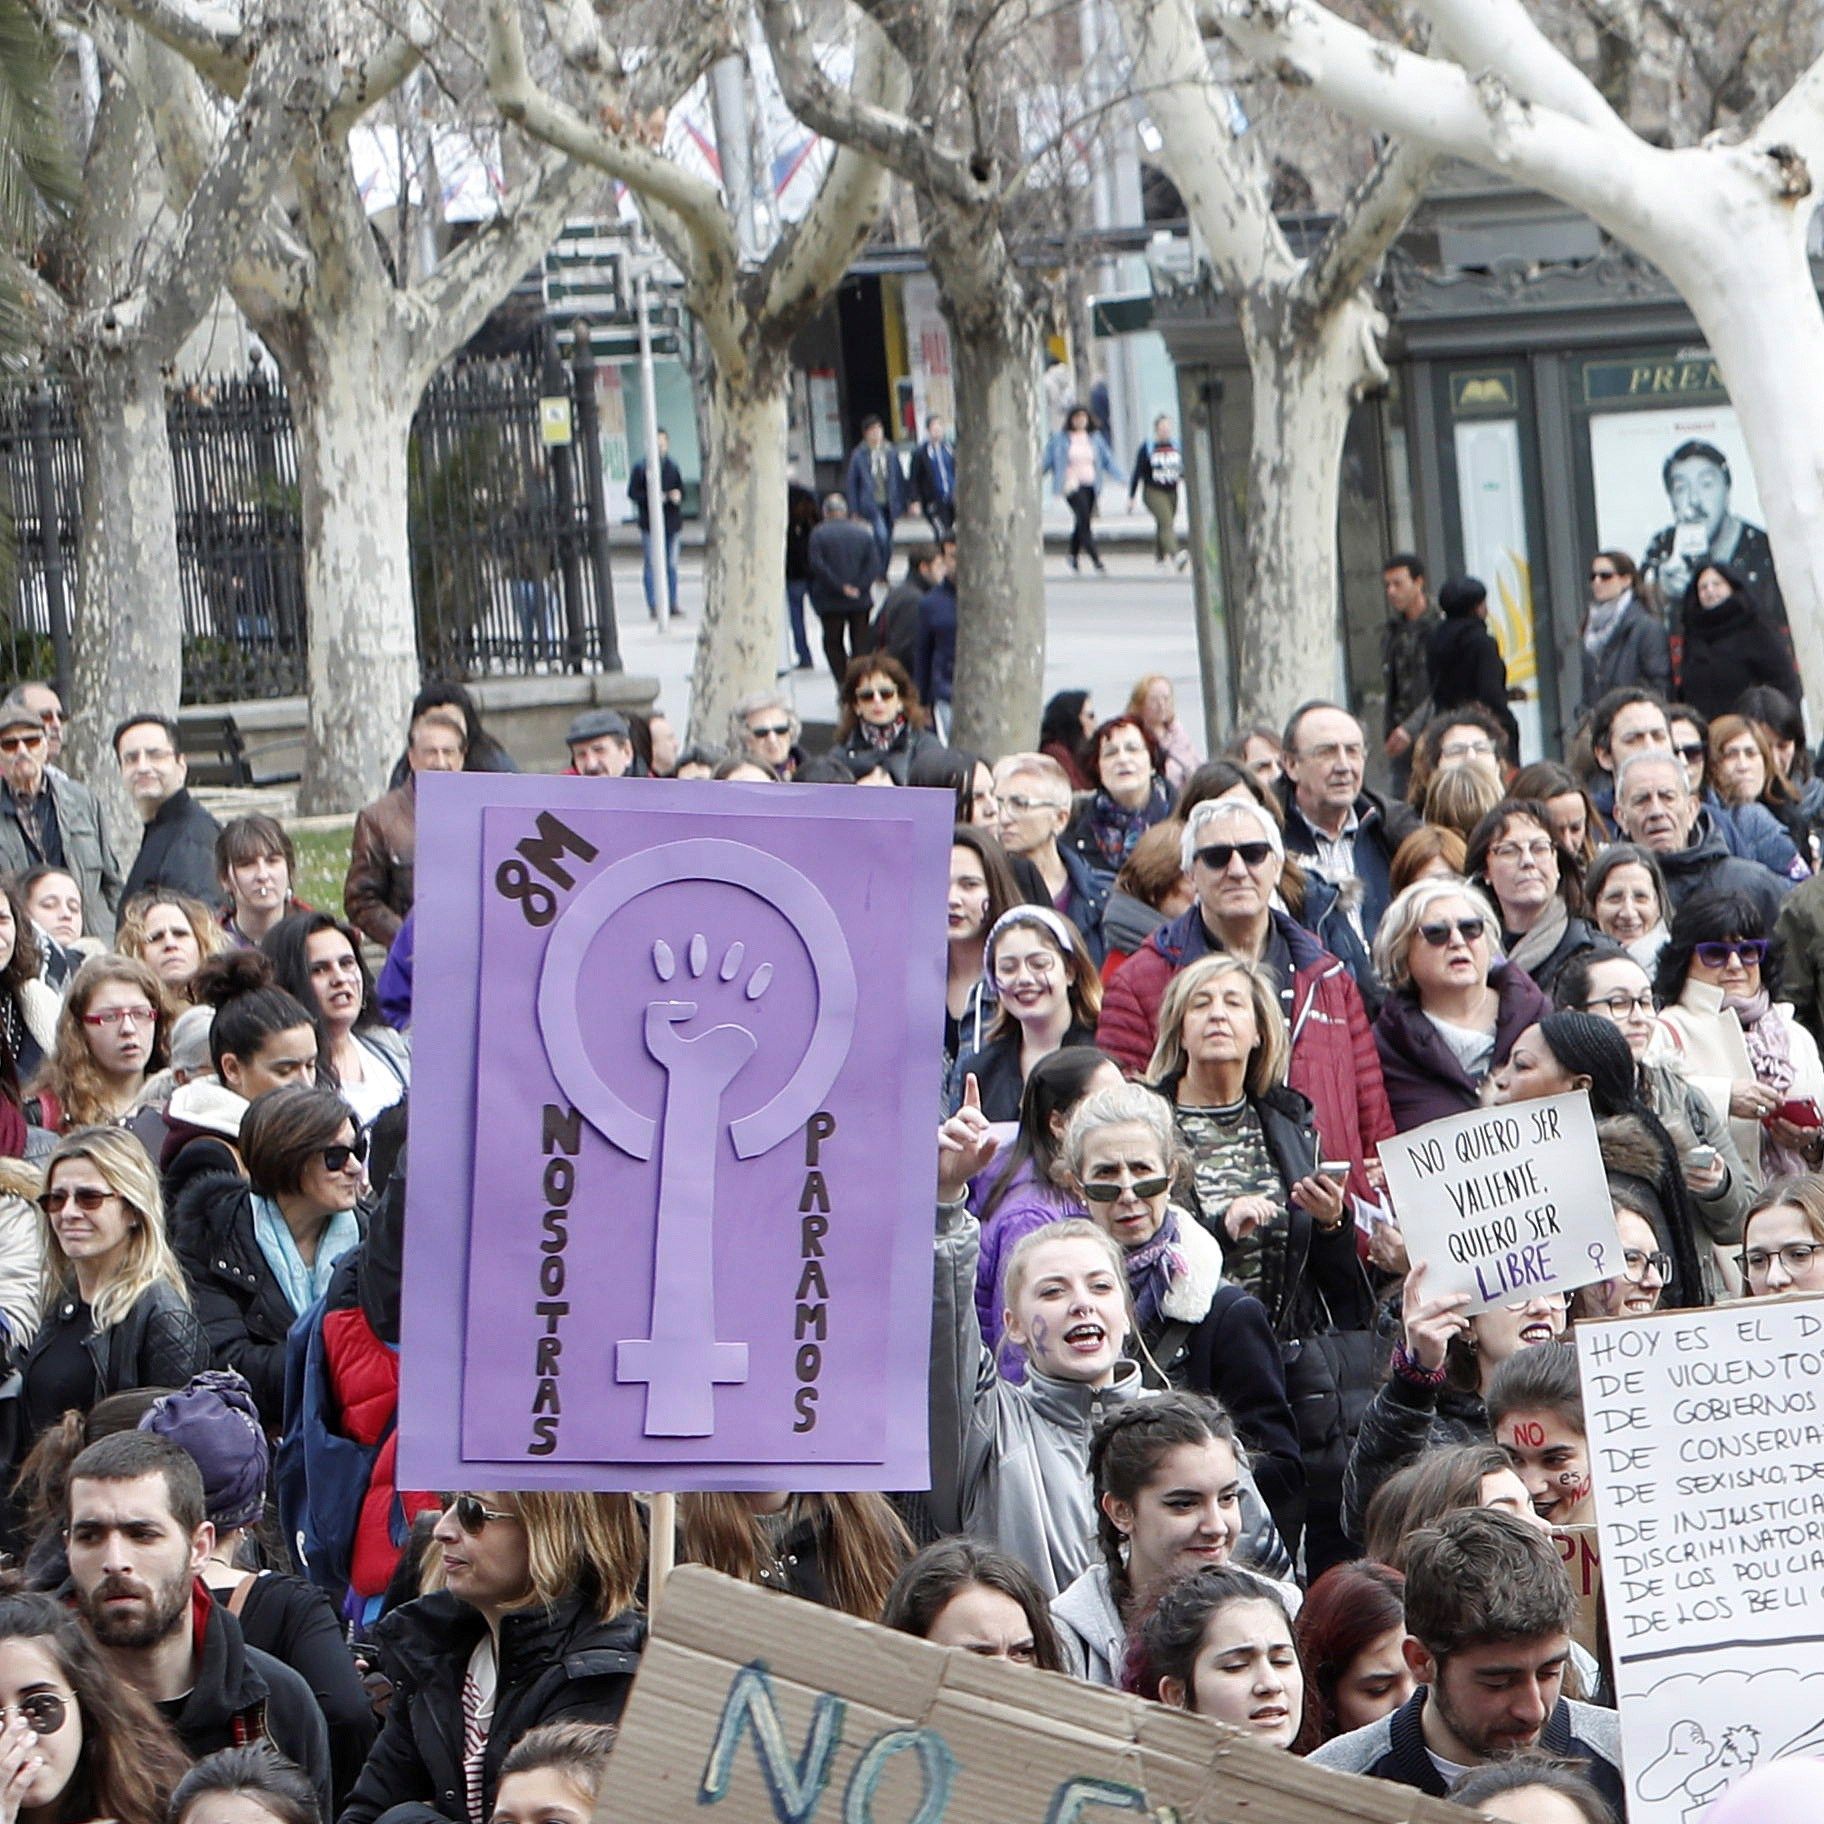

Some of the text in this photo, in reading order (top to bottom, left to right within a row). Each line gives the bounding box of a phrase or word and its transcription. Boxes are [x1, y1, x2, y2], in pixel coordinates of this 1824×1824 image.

[1628, 359, 1726, 395] PREN
[494, 810, 600, 927] 8M
[1407, 1106, 1562, 1179] NO QUIERO SER
[1448, 1203, 1561, 1264] QUIERO SER
[527, 1104, 582, 1456] NOSOTRAS
[792, 1112, 836, 1434] PARAMOS
[1475, 1242, 1558, 1303] LIBRE
[1591, 1331, 1660, 1366] HOY
[1675, 1326, 1709, 1351] ES
[1737, 1319, 1772, 1342] EL
[1592, 1371, 1644, 1398] DE
[1594, 1407, 1652, 1434] DE
[1674, 1391, 1816, 1425] GOBIERNOS
[1514, 1422, 1544, 1447] NO
[1560, 1471, 1580, 1485] es
[1600, 1446, 1657, 1473] DE
[1571, 1474, 1591, 1506] NO
[1607, 1483, 1656, 1507] DE
[1607, 1519, 1658, 1546] DE
[1620, 1580, 1664, 1603] DE
[1675, 1568, 1715, 1591] LOS
[1624, 1610, 1671, 1639] DE
[1677, 1596, 1733, 1625] LOS
